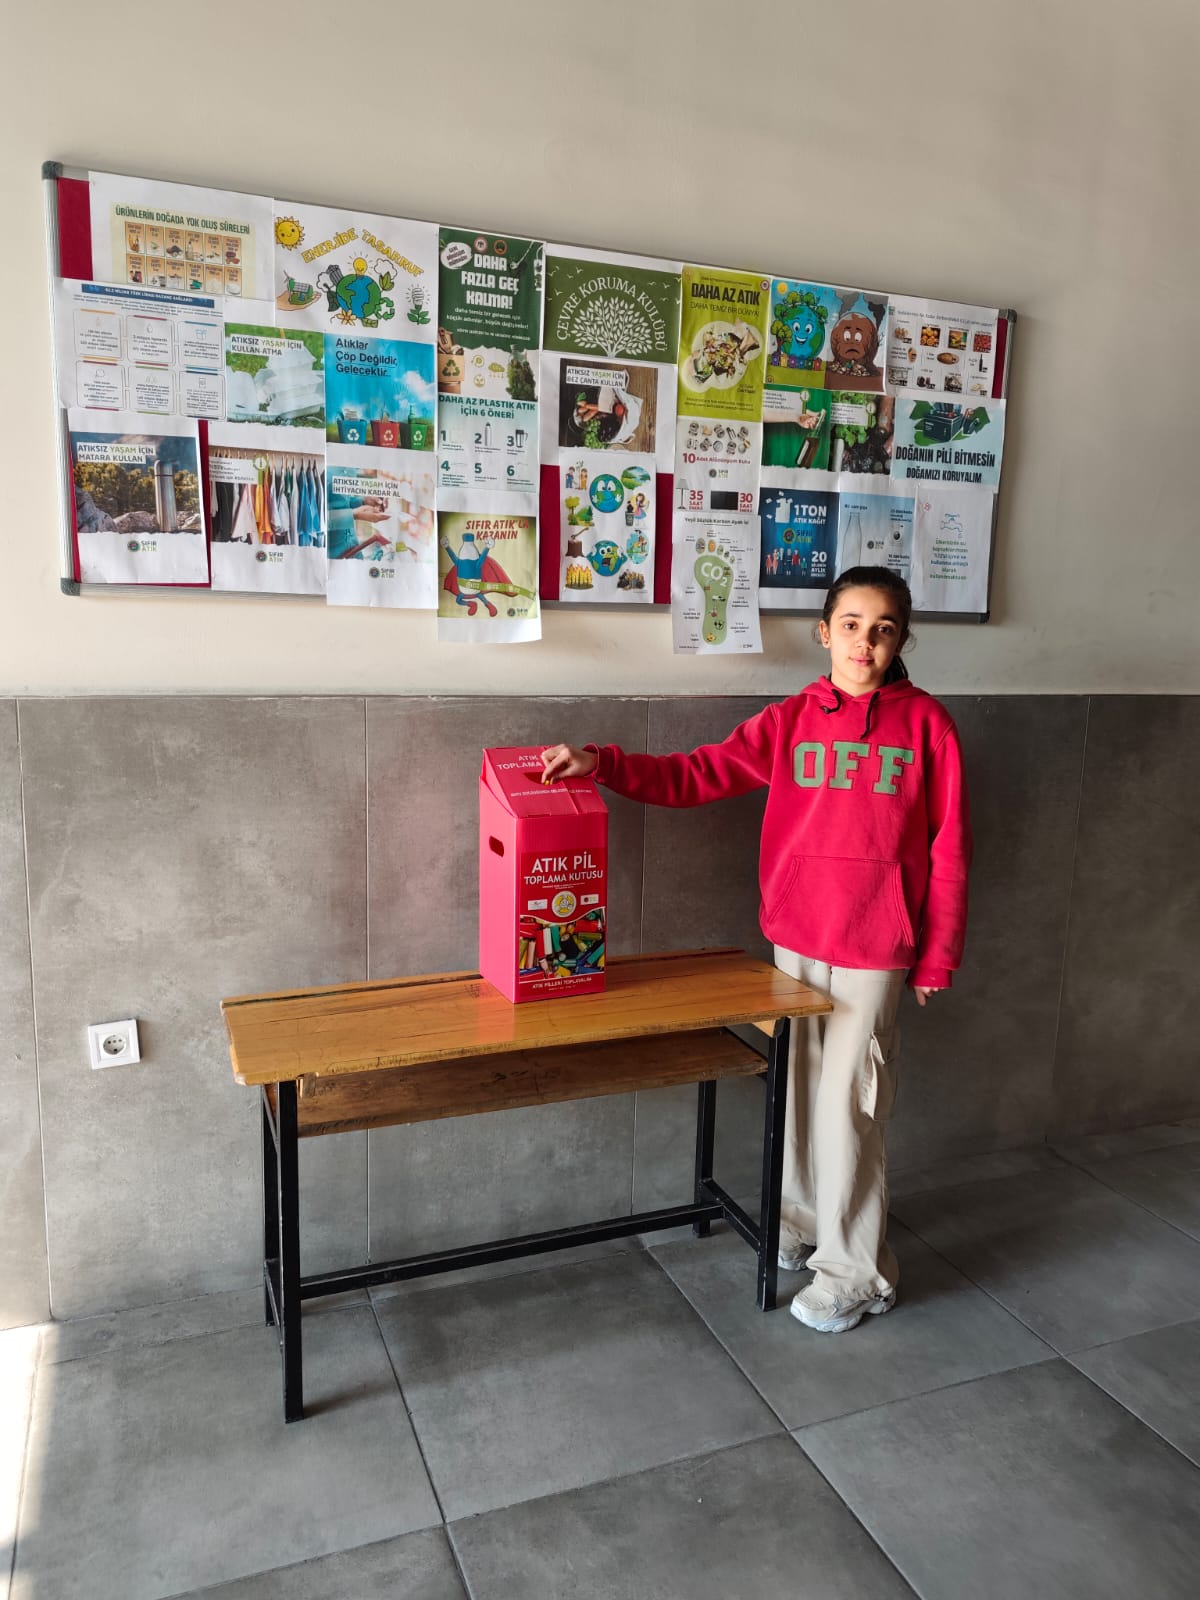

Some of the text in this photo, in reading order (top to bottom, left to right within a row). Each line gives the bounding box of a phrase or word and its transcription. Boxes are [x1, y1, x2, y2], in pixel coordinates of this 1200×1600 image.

[116, 205, 250, 234] ÜRÜNLERİN DOĞADA YOK OLUŞ SÜRELERİ
[301, 228, 424, 278] ENERJİDE TASARRUF
[474, 254, 507, 271] DAHA
[461, 270, 519, 295] FAZLA GEÇ
[466, 290, 513, 310] KALMA!
[692, 283, 760, 306] DAHA AZ ATIK
[690, 302, 708, 310] DAHA
[557, 276, 668, 351] ÇEVRE KORUMA KULÜBÜ
[262, 339, 286, 348] YAŞAM
[288, 341, 302, 350] İÇİN
[336, 338, 368, 350] Atıklar
[336, 351, 356, 364] Çöp
[568, 368, 624, 380] ATIKSIZ YAŞAM İÇİN
[600, 379, 623, 388] KULLAN
[439, 394, 464, 404] DAHA
[466, 397, 476, 406] AZ
[516, 402, 535, 411] ATIK
[460, 405, 478, 416] İÇİN
[488, 408, 514, 419] ÖNERİ
[440, 430, 446, 442] 1
[474, 432, 482, 444] 2
[507, 436, 514, 447] 3
[78, 444, 154, 456] ATIKSIZ YAŞAM İÇİN
[896, 444, 996, 467] DOĞANIN PİLİ BİTMESİN
[78, 454, 110, 462] MATARA
[683, 453, 696, 464] 10
[440, 460, 450, 472] 4
[474, 462, 482, 474] 5
[506, 465, 514, 476] 6
[906, 466, 982, 483] DOĞAMIZI KORUYALIM
[334, 478, 398, 490] ATIKSIZ YAŞAM İÇİN
[334, 486, 367, 494] İHTİYACIN
[690, 490, 703, 500] 35
[740, 492, 753, 503] 30
[466, 520, 491, 530] SIFIR
[476, 530, 518, 540] KAZANIN
[812, 552, 827, 562] 20
[496, 761, 542, 770] TOPLAMA
[793, 740, 914, 795] OFF
[532, 851, 596, 874] ATIK PİL
[524, 870, 603, 885] TOPLAMA KUTUSU
